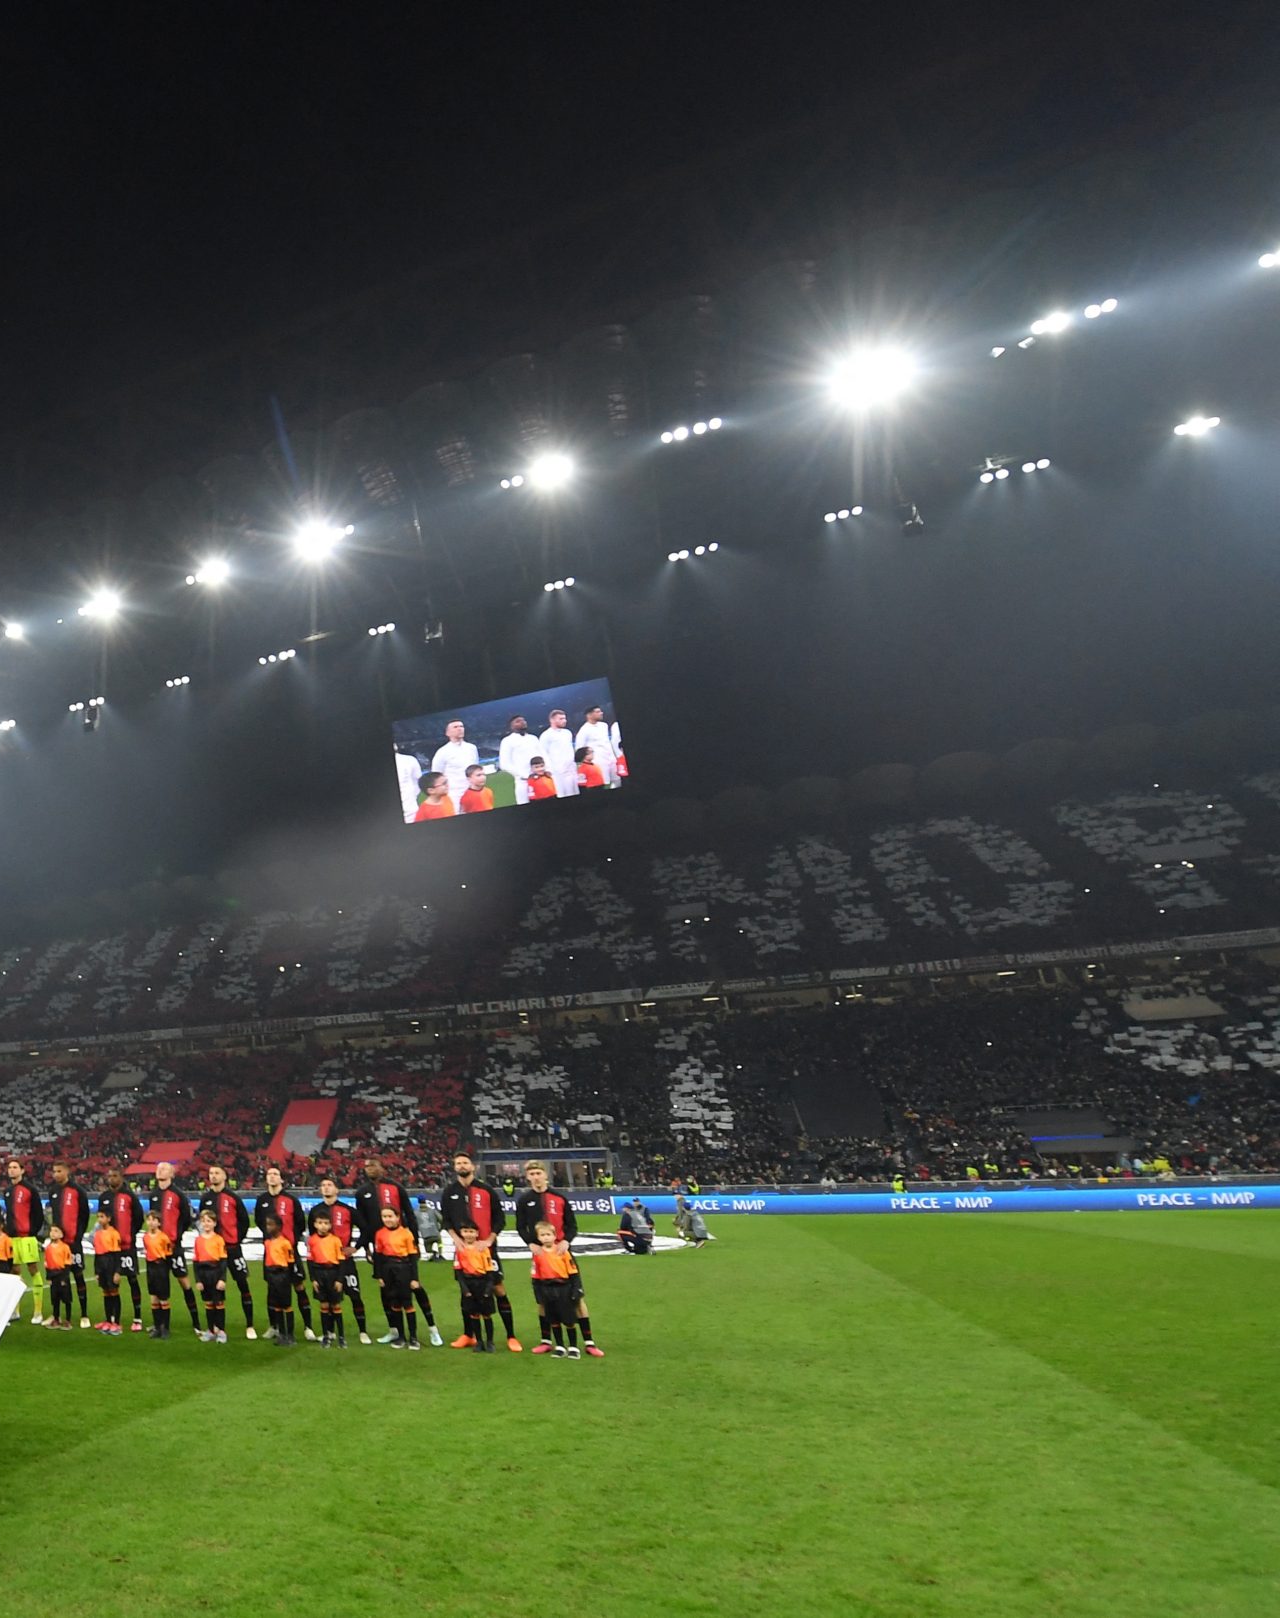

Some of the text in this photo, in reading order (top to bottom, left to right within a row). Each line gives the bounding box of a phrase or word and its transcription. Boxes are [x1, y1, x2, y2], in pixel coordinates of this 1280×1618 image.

[686, 1199, 720, 1211] ACE
[890, 1196, 941, 1209] PEACE
[1138, 1192, 1195, 1206] PEACE
[120, 1256, 133, 1268] 20
[170, 1255, 184, 1269] 24
[345, 1275, 358, 1287] 10
